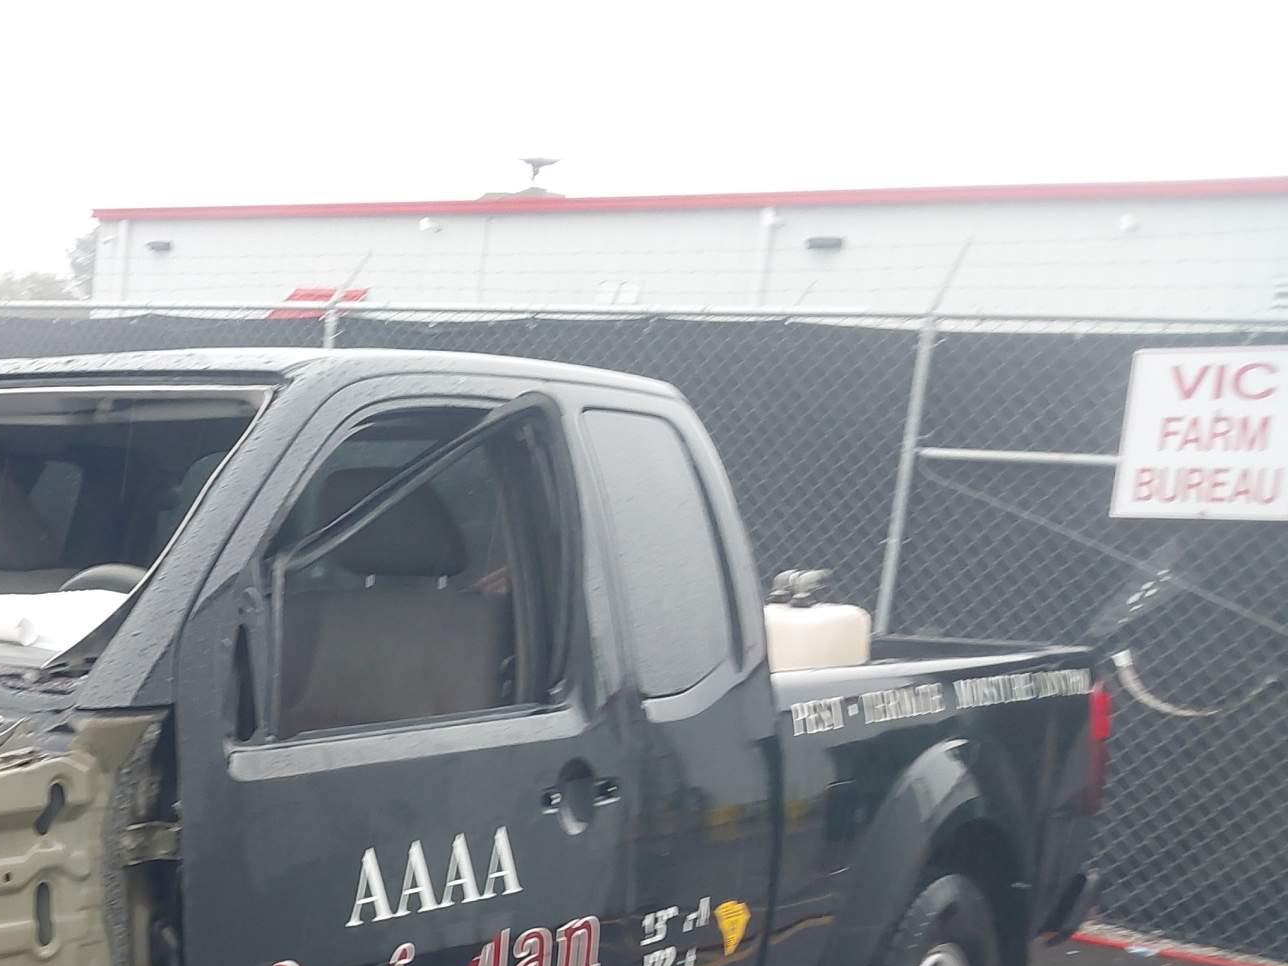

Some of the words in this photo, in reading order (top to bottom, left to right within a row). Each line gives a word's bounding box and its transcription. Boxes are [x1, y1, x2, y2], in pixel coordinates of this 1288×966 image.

[1172, 362, 1279, 400] VIC
[1159, 415, 1273, 451] FARM
[1133, 467, 1284, 503] BUREAU
[345, 825, 524, 927] AAAA
